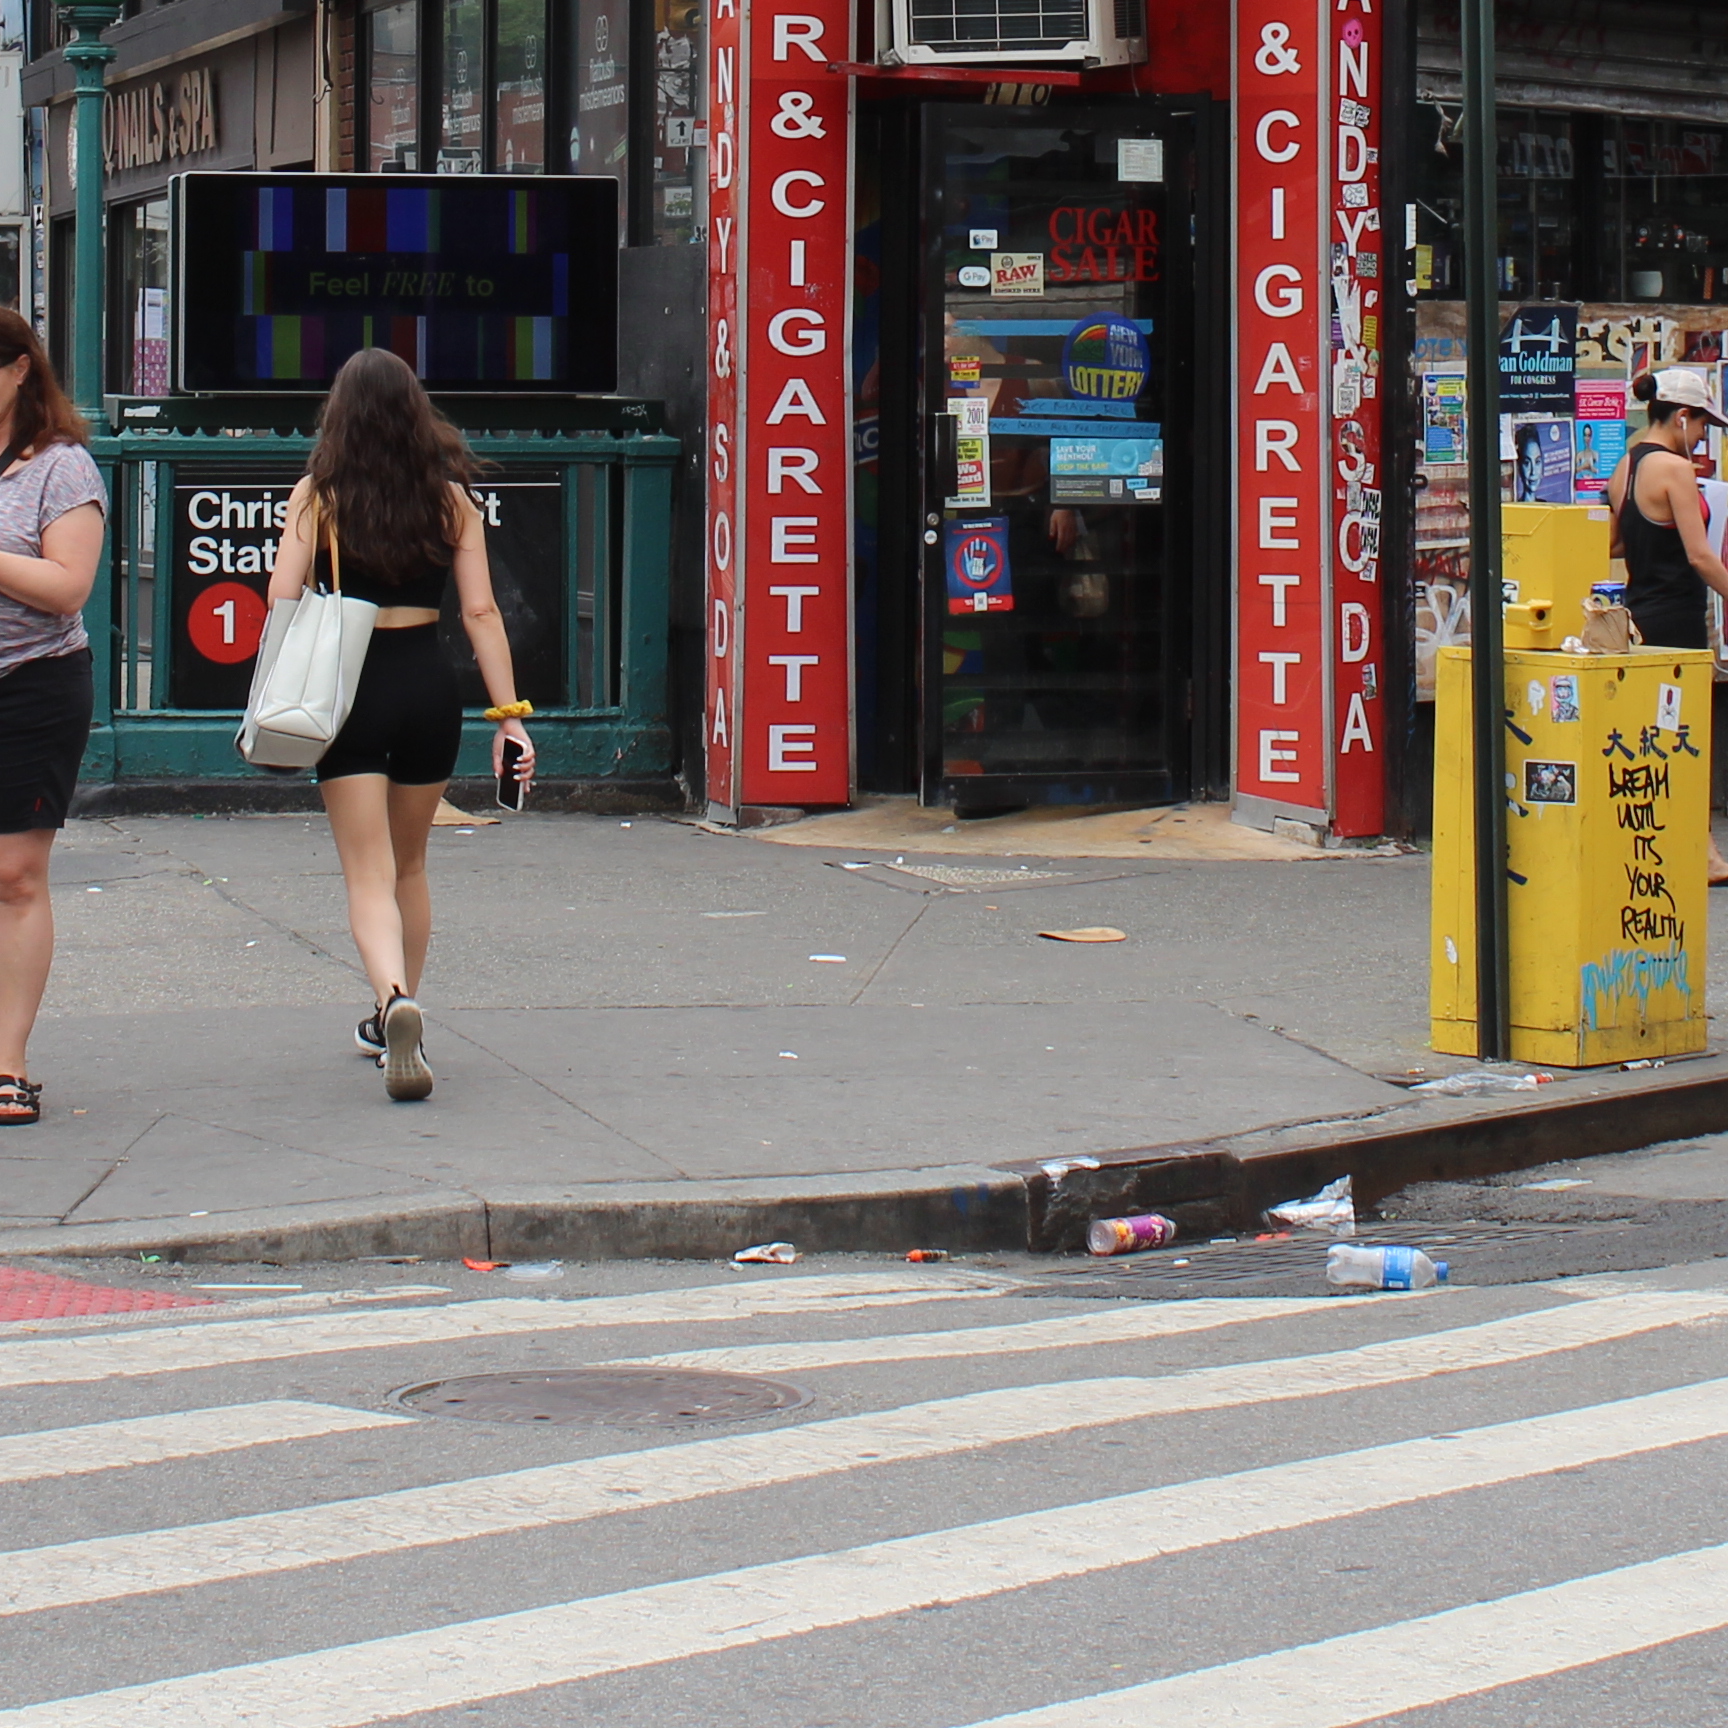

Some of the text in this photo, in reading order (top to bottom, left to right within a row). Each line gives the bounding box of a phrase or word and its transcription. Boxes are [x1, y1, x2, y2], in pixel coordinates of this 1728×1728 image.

[118, 67, 216, 170] NAILS & SPA
[1049, 207, 1160, 246] CIGAR
[972, 273, 987, 283] Pay
[995, 264, 1037, 284] RAW
[1049, 246, 1160, 282] SALE
[309, 271, 494, 296] Feel FREE to
[1110, 325, 1139, 345] NEW
[1110, 342, 1144, 368] YORK
[1519, 350, 1573, 373] Goldman
[1070, 365, 1145, 399] LOTTERY
[1510, 375, 1556, 386] FOR CONGRESS
[967, 407, 985, 425] 2001
[1076, 445, 1096, 453] YOUR
[1253, 110, 1303, 784] CIGARETTE
[767, 170, 828, 772] CIGARETTE
[1056, 463, 1074, 471] STOP
[712, 423, 731, 749] SODA
[1337, 421, 1371, 754] SODA
[213, 600, 235, 644] 1
[1602, 724, 1699, 761] 大紀元
[1609, 762, 1670, 801] DREAM
[1634, 835, 1662, 866] ITS
[1624, 863, 1676, 914] YOUR
[1621, 906, 1684, 955] REALITY
